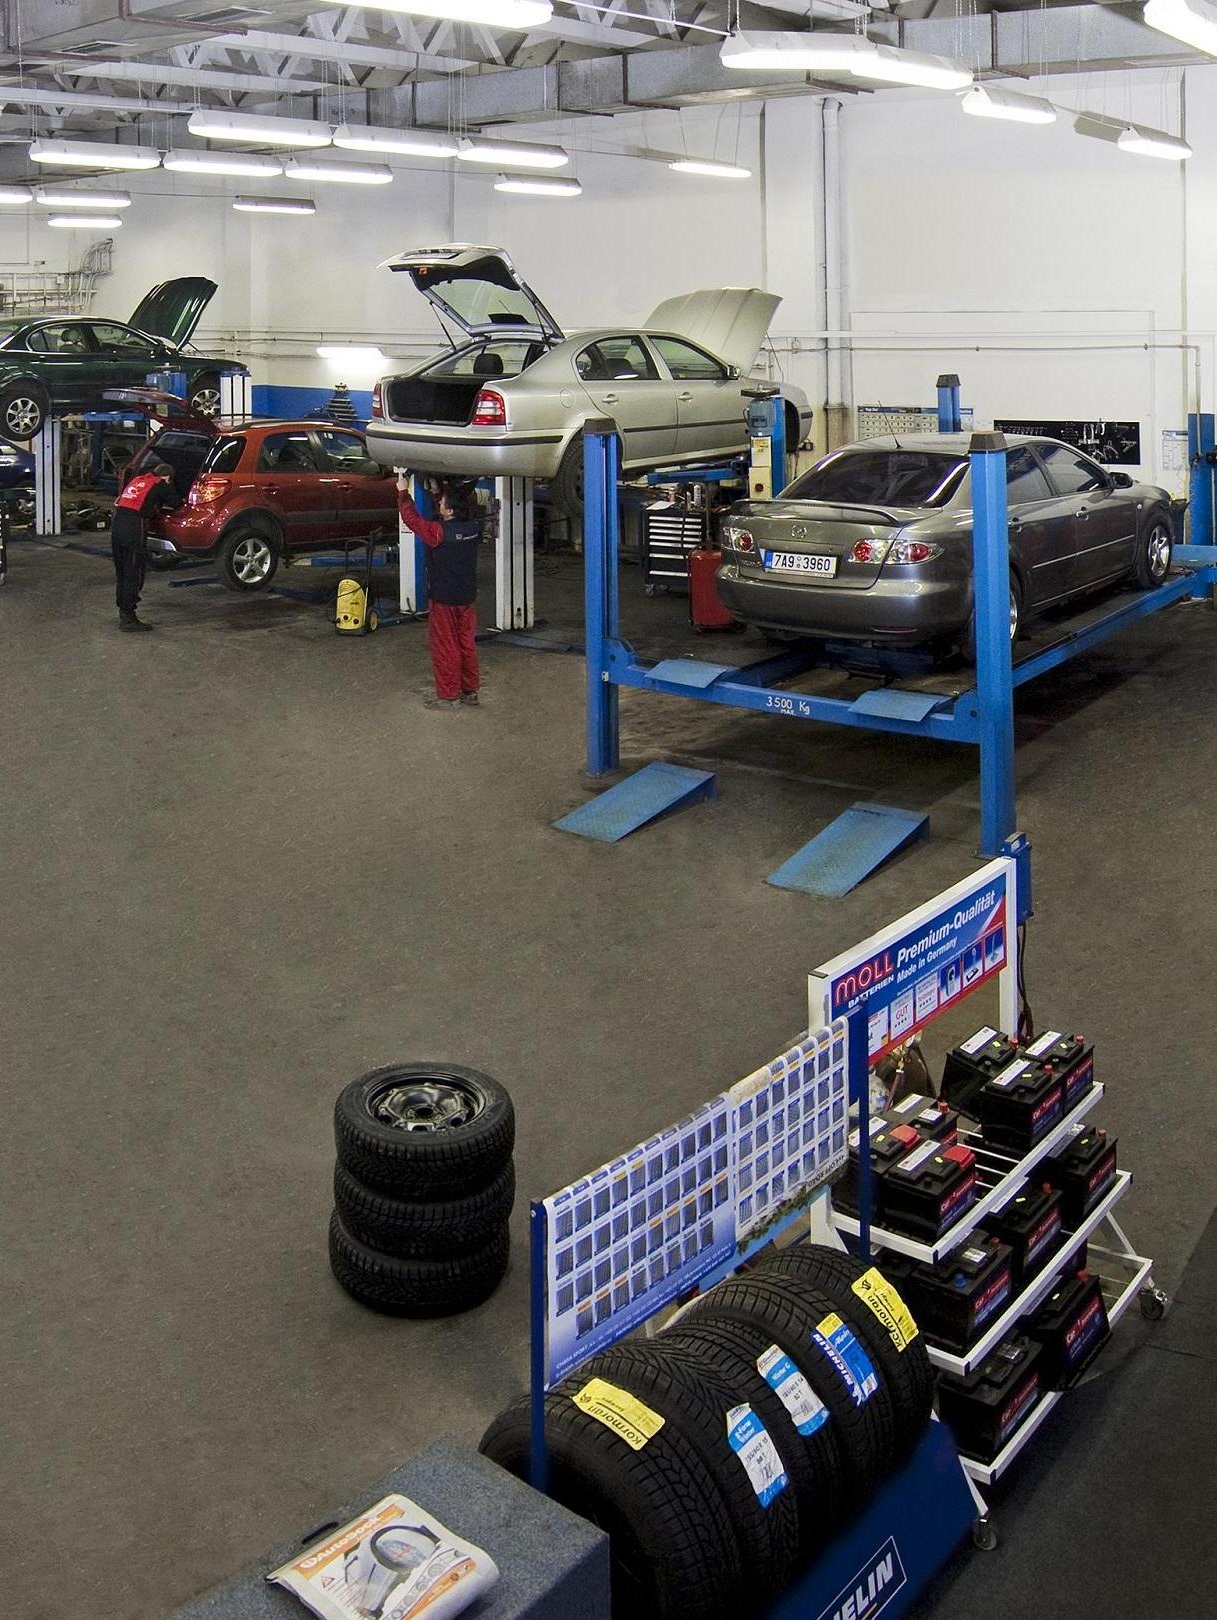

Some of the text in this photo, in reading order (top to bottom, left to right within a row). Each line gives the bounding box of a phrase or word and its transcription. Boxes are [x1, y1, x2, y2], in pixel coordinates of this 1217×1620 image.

[775, 554, 795, 569] 7A9
[803, 557, 831, 571] 3960
[799, 701, 811, 715] Kg
[896, 890, 996, 968] Premium-Qualität
[896, 964, 917, 984] Made
[927, 936, 958, 963] Germany
[895, 1003, 908, 1019] GUT
[813, 1333, 854, 1385] MICHELIN
[587, 1405, 642, 1445] Kormoran
[833, 1551, 894, 1620] ELIN
